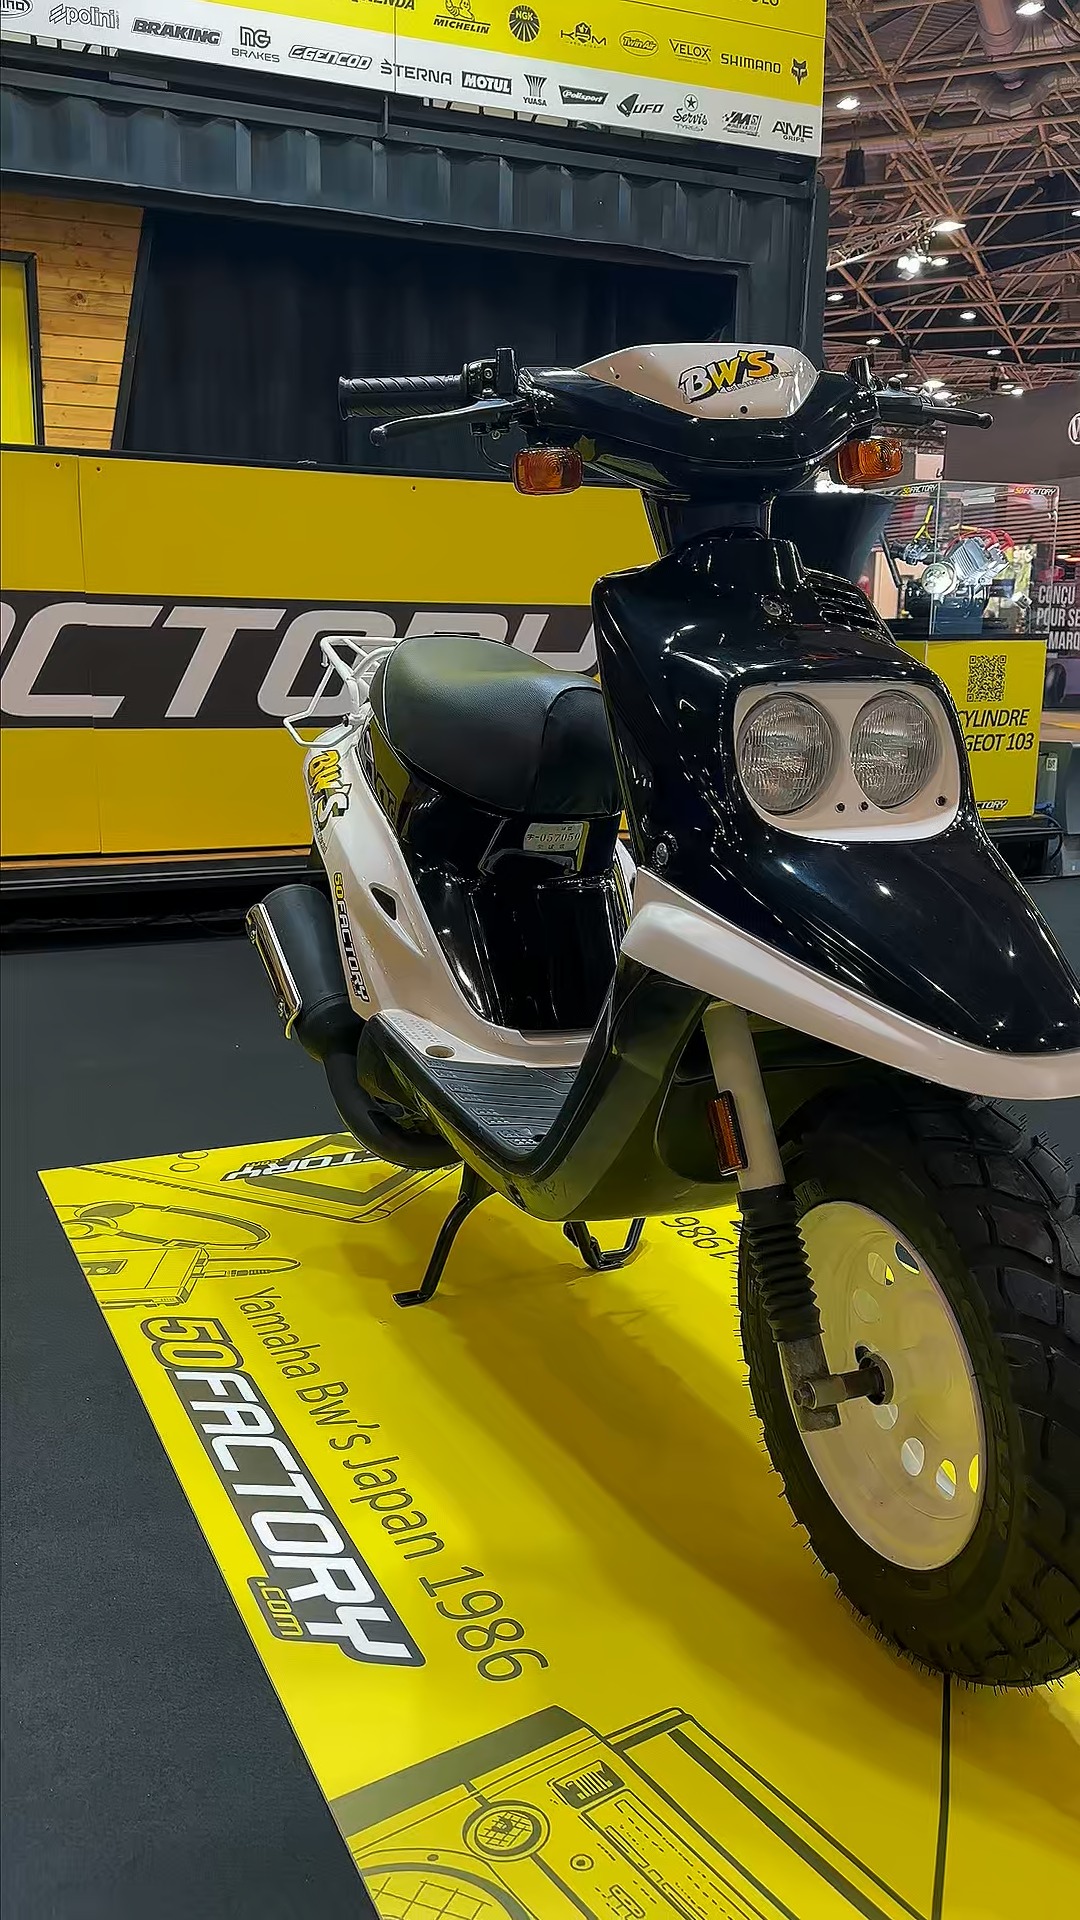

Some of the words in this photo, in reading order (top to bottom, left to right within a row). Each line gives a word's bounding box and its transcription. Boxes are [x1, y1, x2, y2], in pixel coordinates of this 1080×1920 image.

[65, 6, 116, 29] polini
[515, 10, 534, 21] NGK
[133, 19, 221, 44] BRAKING
[433, 18, 490, 34] MICHELIN
[622, 36, 643, 48] Twin
[669, 39, 711, 62] VELOX
[231, 48, 280, 63] BRAKES
[720, 53, 781, 74] SHIMANO
[463, 73, 511, 93] MOTUL
[522, 96, 548, 107] YUASA
[562, 89, 604, 103] Polisport
[632, 103, 664, 114] UFO
[672, 108, 709, 126] Servis
[783, 134, 805, 143] GRIPS
[679, 350, 781, 402] BW'S
[1038, 585, 1076, 607] CONÇU
[1036, 607, 1066, 627] POUR
[1006, 732, 1035, 750] 103
[140, 1316, 416, 1662] 50FACTORY
[234, 1286, 321, 1379] Yamaha
[295, 1382, 380, 1451] Bw's
[343, 1455, 445, 1560] Japan
[418, 1565, 548, 1682] 1986
[254, 1579, 305, 1637] .com
